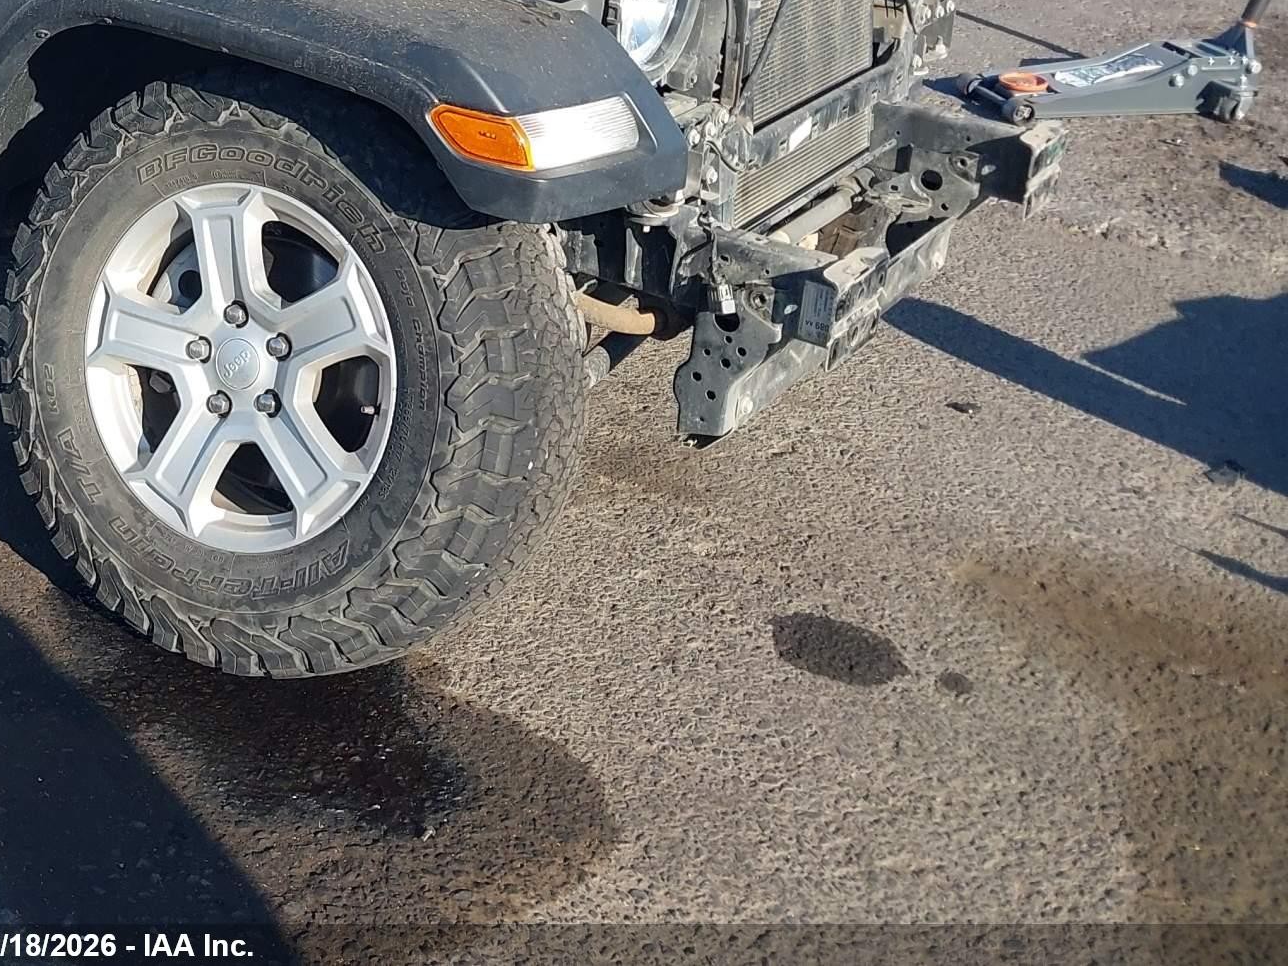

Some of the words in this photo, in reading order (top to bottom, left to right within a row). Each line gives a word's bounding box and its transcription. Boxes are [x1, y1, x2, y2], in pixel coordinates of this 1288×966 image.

[136, 144, 386, 254] BFGoodrich
[223, 350, 250, 378] Jeep
[57, 427, 103, 505] T/A
